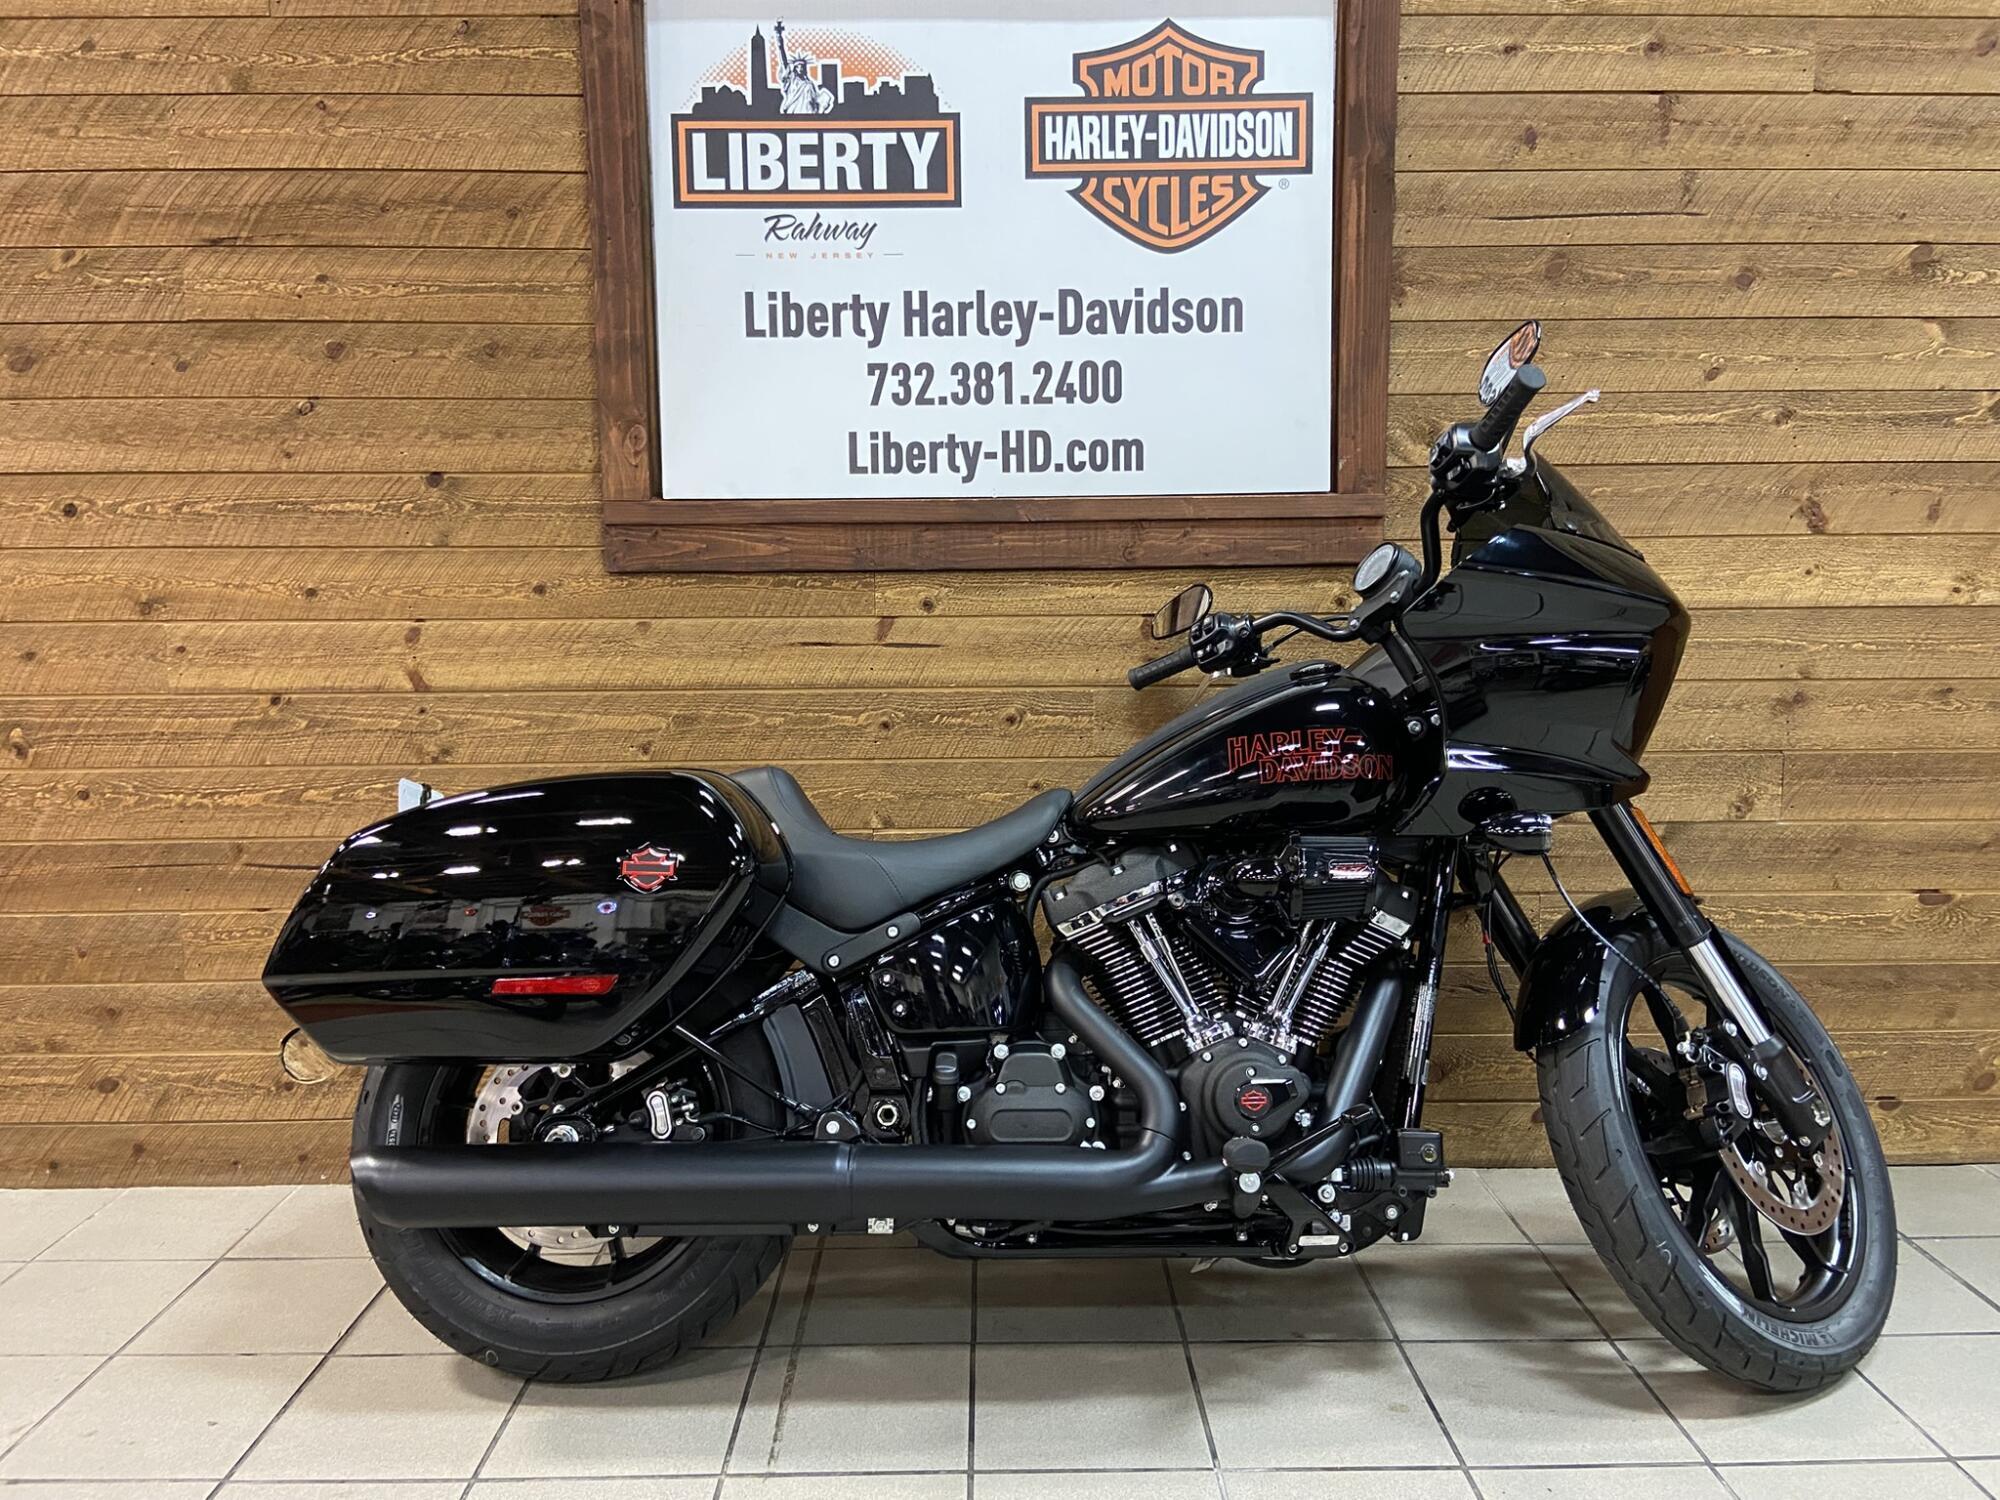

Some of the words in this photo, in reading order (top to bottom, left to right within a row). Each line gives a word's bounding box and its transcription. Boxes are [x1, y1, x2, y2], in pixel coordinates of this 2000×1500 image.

[1103, 42, 1235, 97] MOTOR
[1045, 111, 1293, 161] HARLEY-DAVIDSON
[691, 131, 940, 191] LIBERTY
[1103, 175, 1234, 236] CYCLES
[763, 212, 878, 250] Rahway
[765, 252, 798, 260] NEW
[811, 251, 875, 260] JERSEY
[744, 290, 890, 348] Liberty
[903, 287, 1244, 347] Harley-Davidson
[866, 360, 1122, 406] 732.381.2400
[847, 430, 1145, 484] Liberty-HD.com
[1227, 728, 1364, 772] HARLEY-
[1258, 753, 1393, 785] DAVIDSON
[1743, 1308, 1820, 1346] MICHELIN
